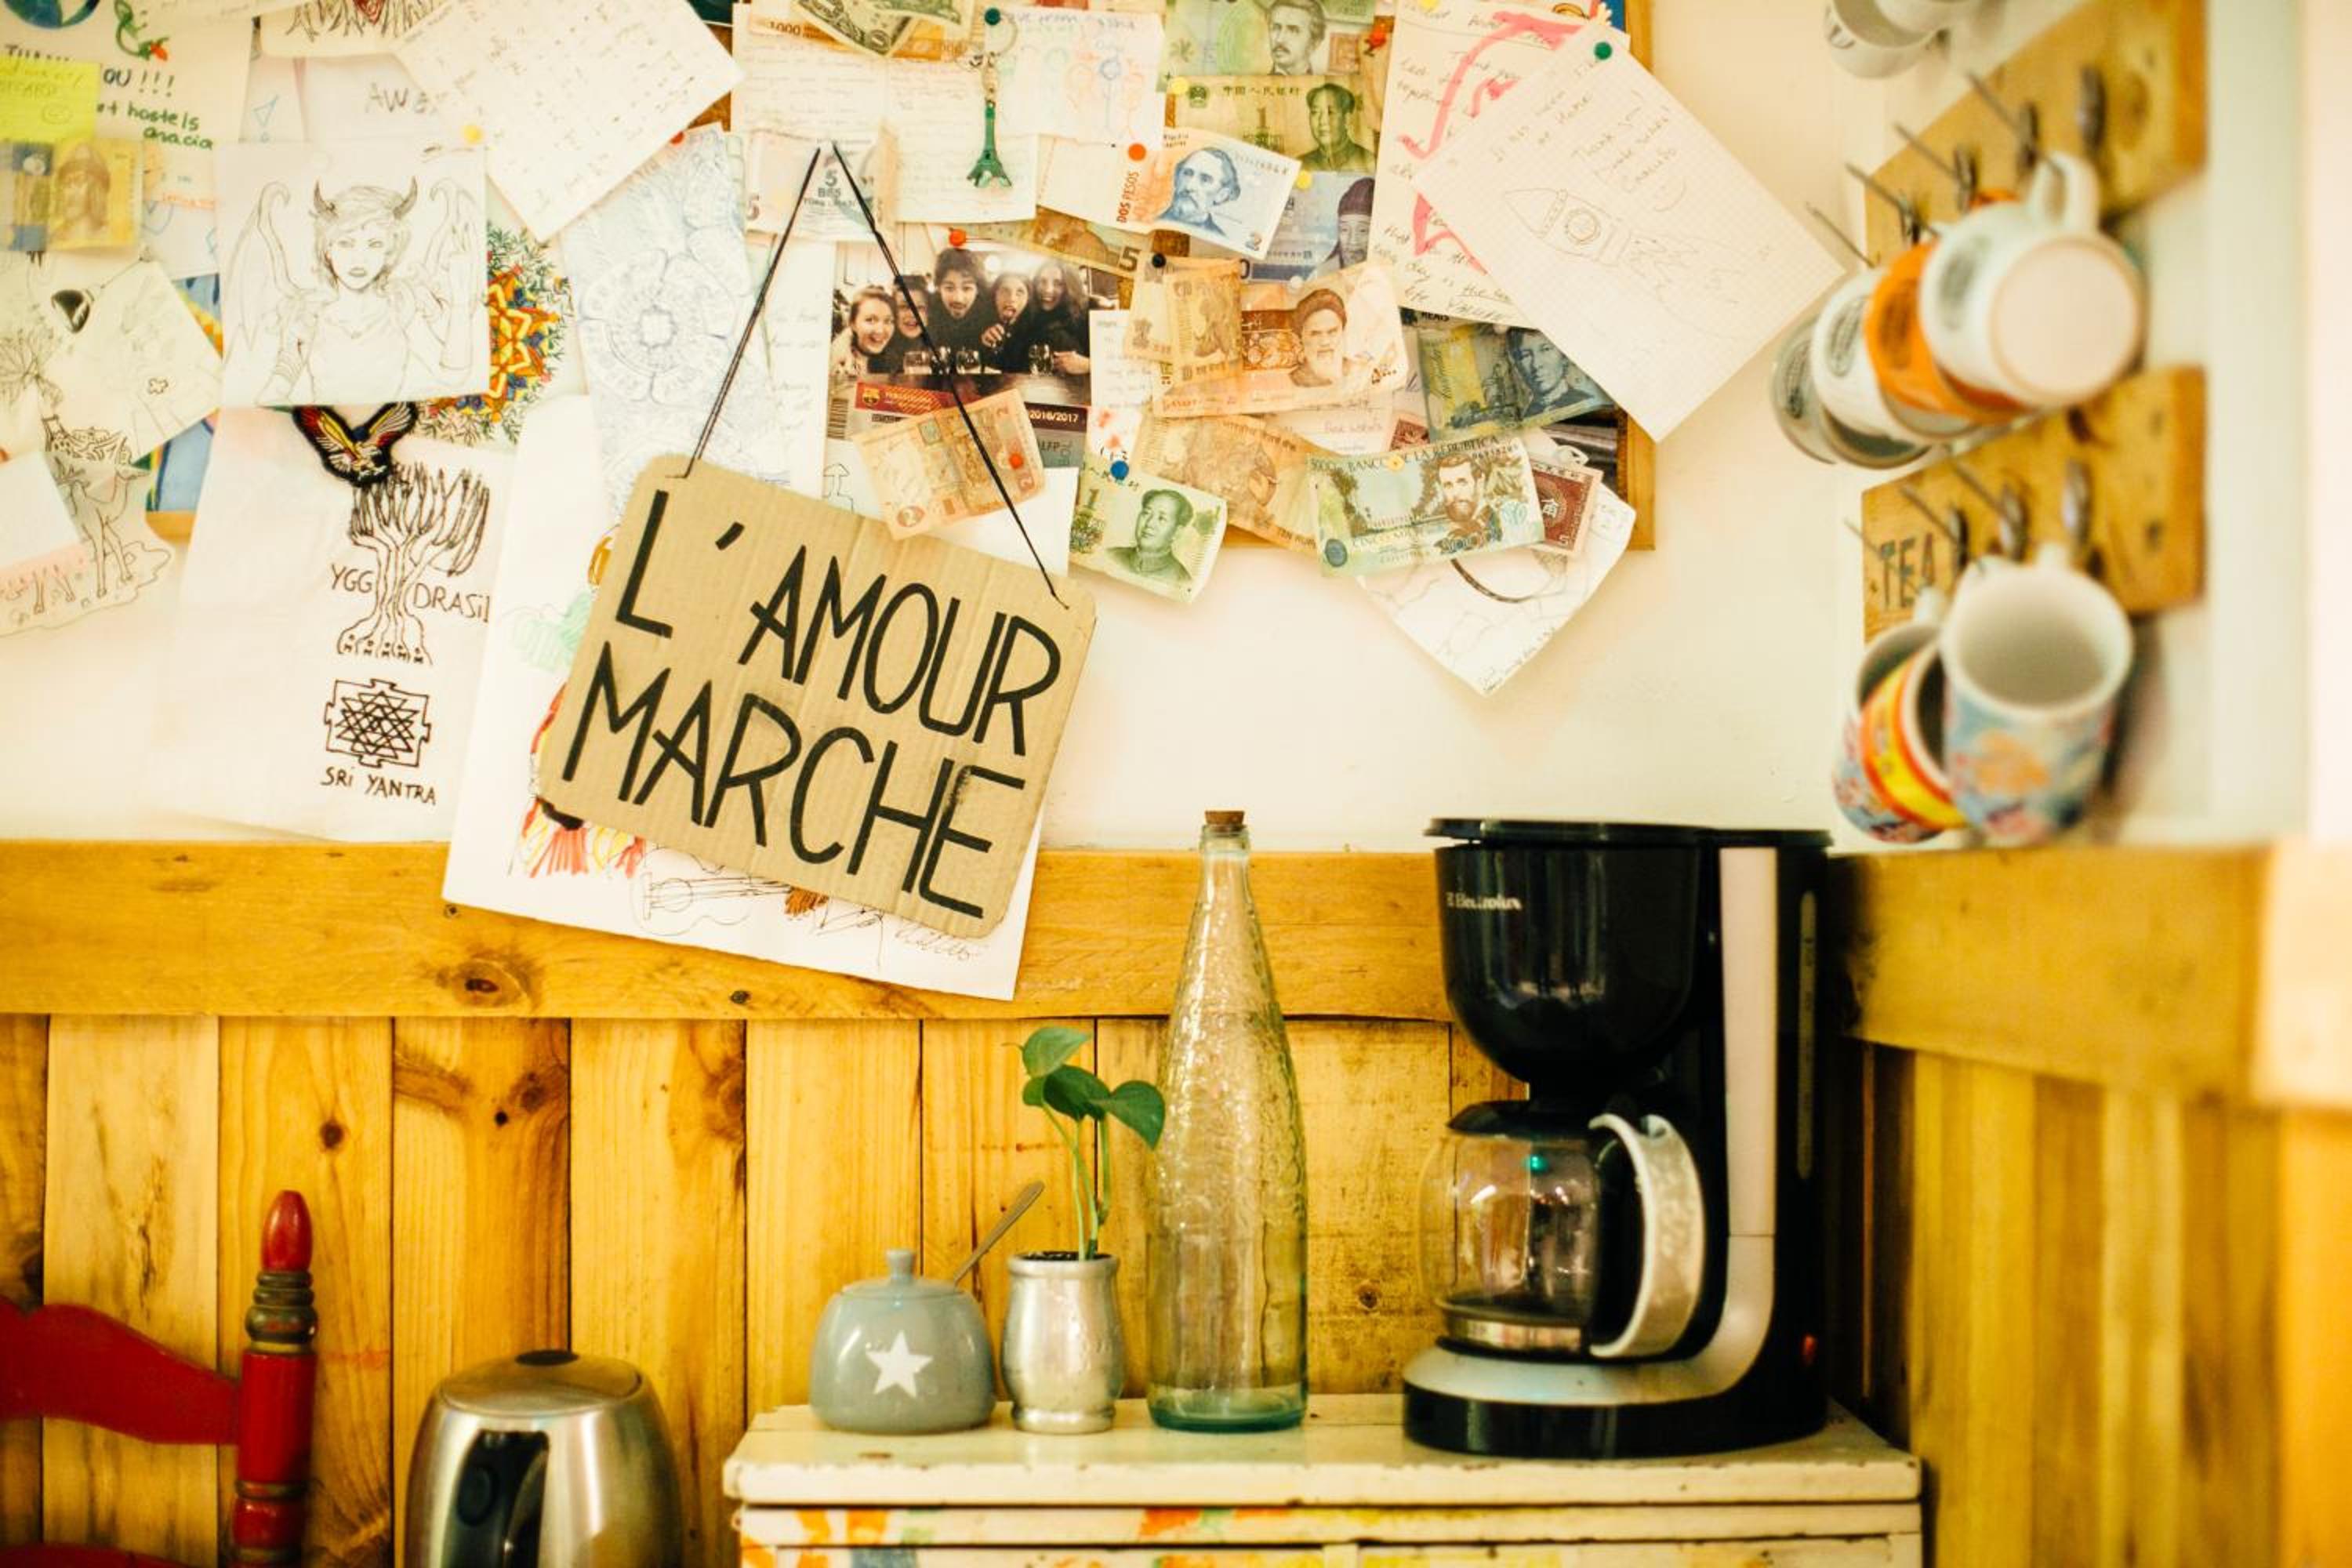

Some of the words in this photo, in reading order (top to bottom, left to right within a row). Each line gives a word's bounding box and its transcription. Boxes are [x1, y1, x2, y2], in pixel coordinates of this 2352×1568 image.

[825, 170, 838, 187] 5
[1121, 171, 1140, 205] PESOS
[1116, 201, 1131, 224] DOS
[1119, 246, 1142, 272] 5
[1029, 410, 1080, 424] 2016/2017
[330, 564, 374, 593] YGG
[1878, 532, 1936, 610] TEA
[364, 774, 437, 806] YANTRA
[561, 641, 1025, 919] MARCHE
